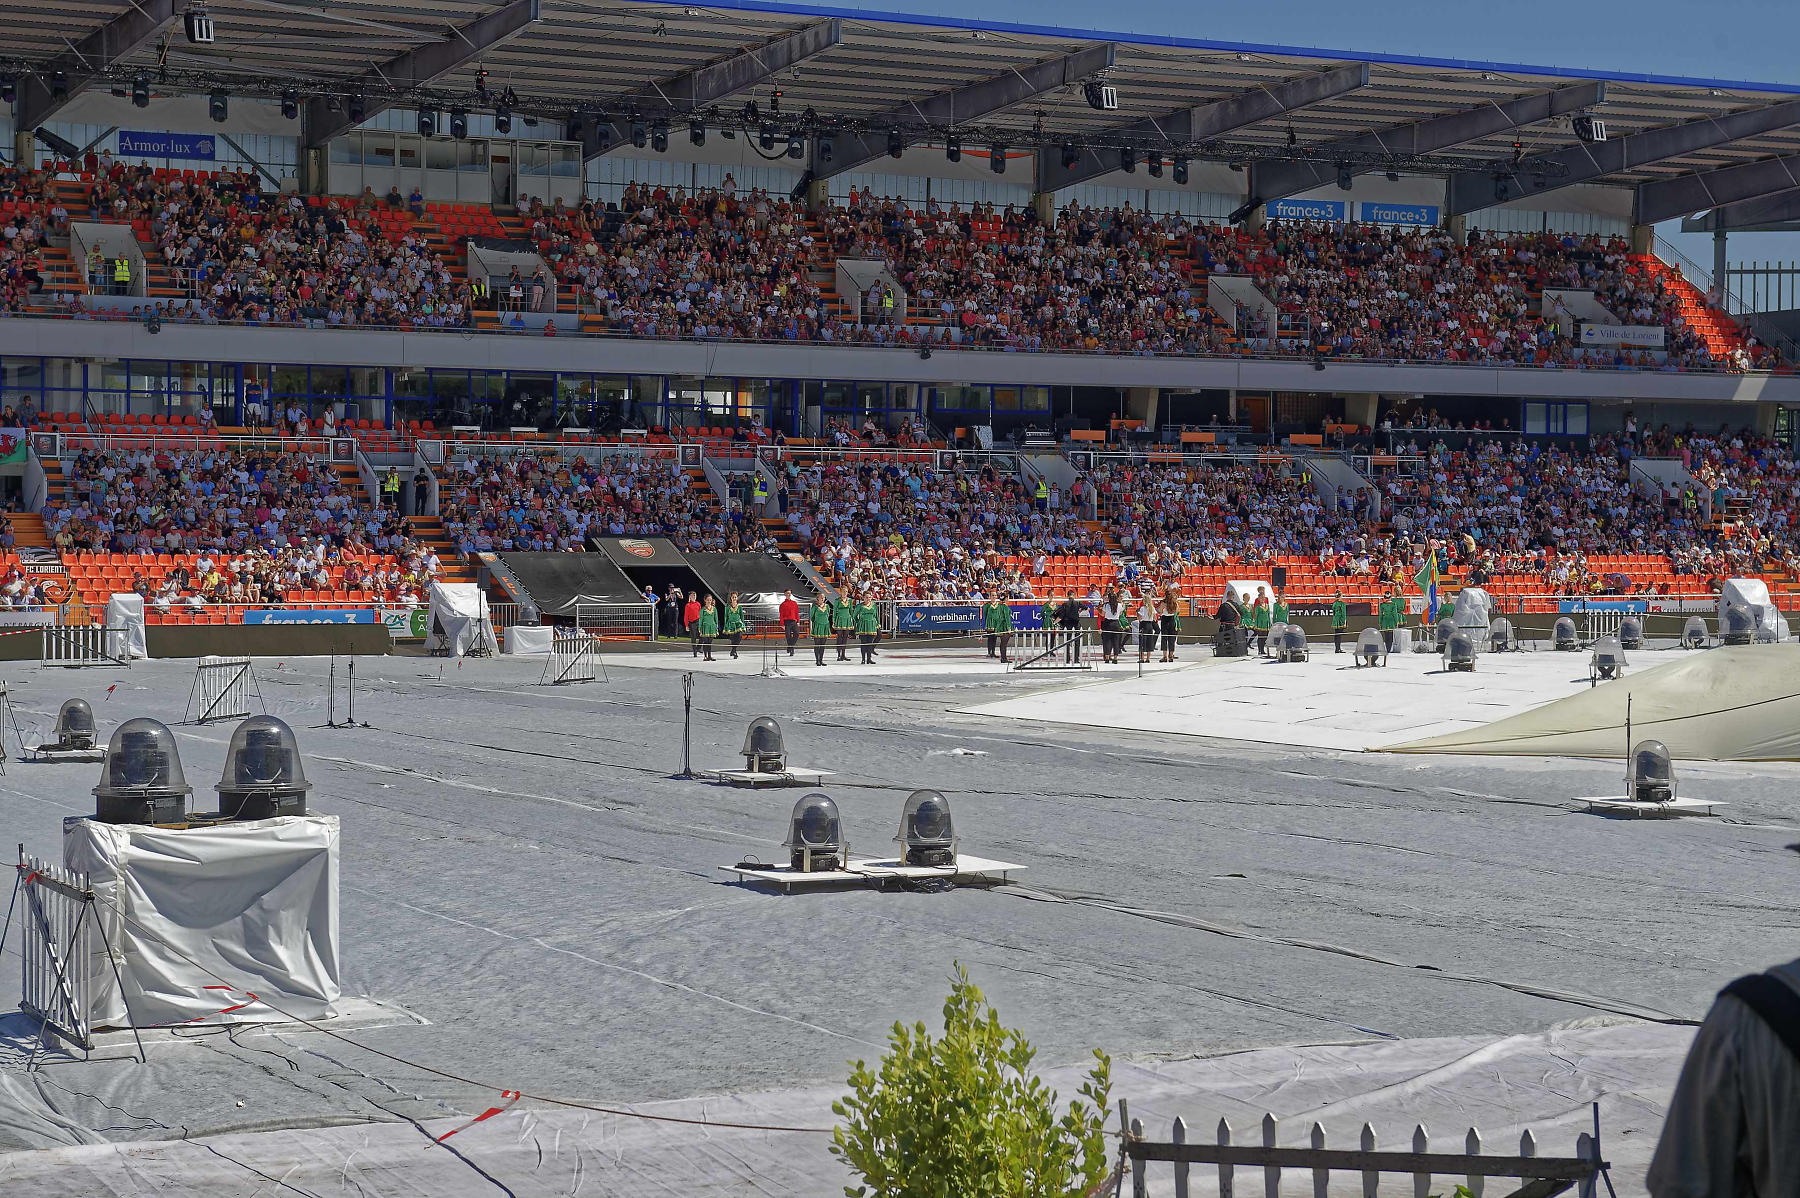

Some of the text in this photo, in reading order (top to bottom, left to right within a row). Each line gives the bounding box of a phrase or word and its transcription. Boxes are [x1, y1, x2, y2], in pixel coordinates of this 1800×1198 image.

[1600, 329, 1620, 339] Ville
[1620, 330, 1630, 339] de
[931, 612, 976, 622] morbihan.fr
